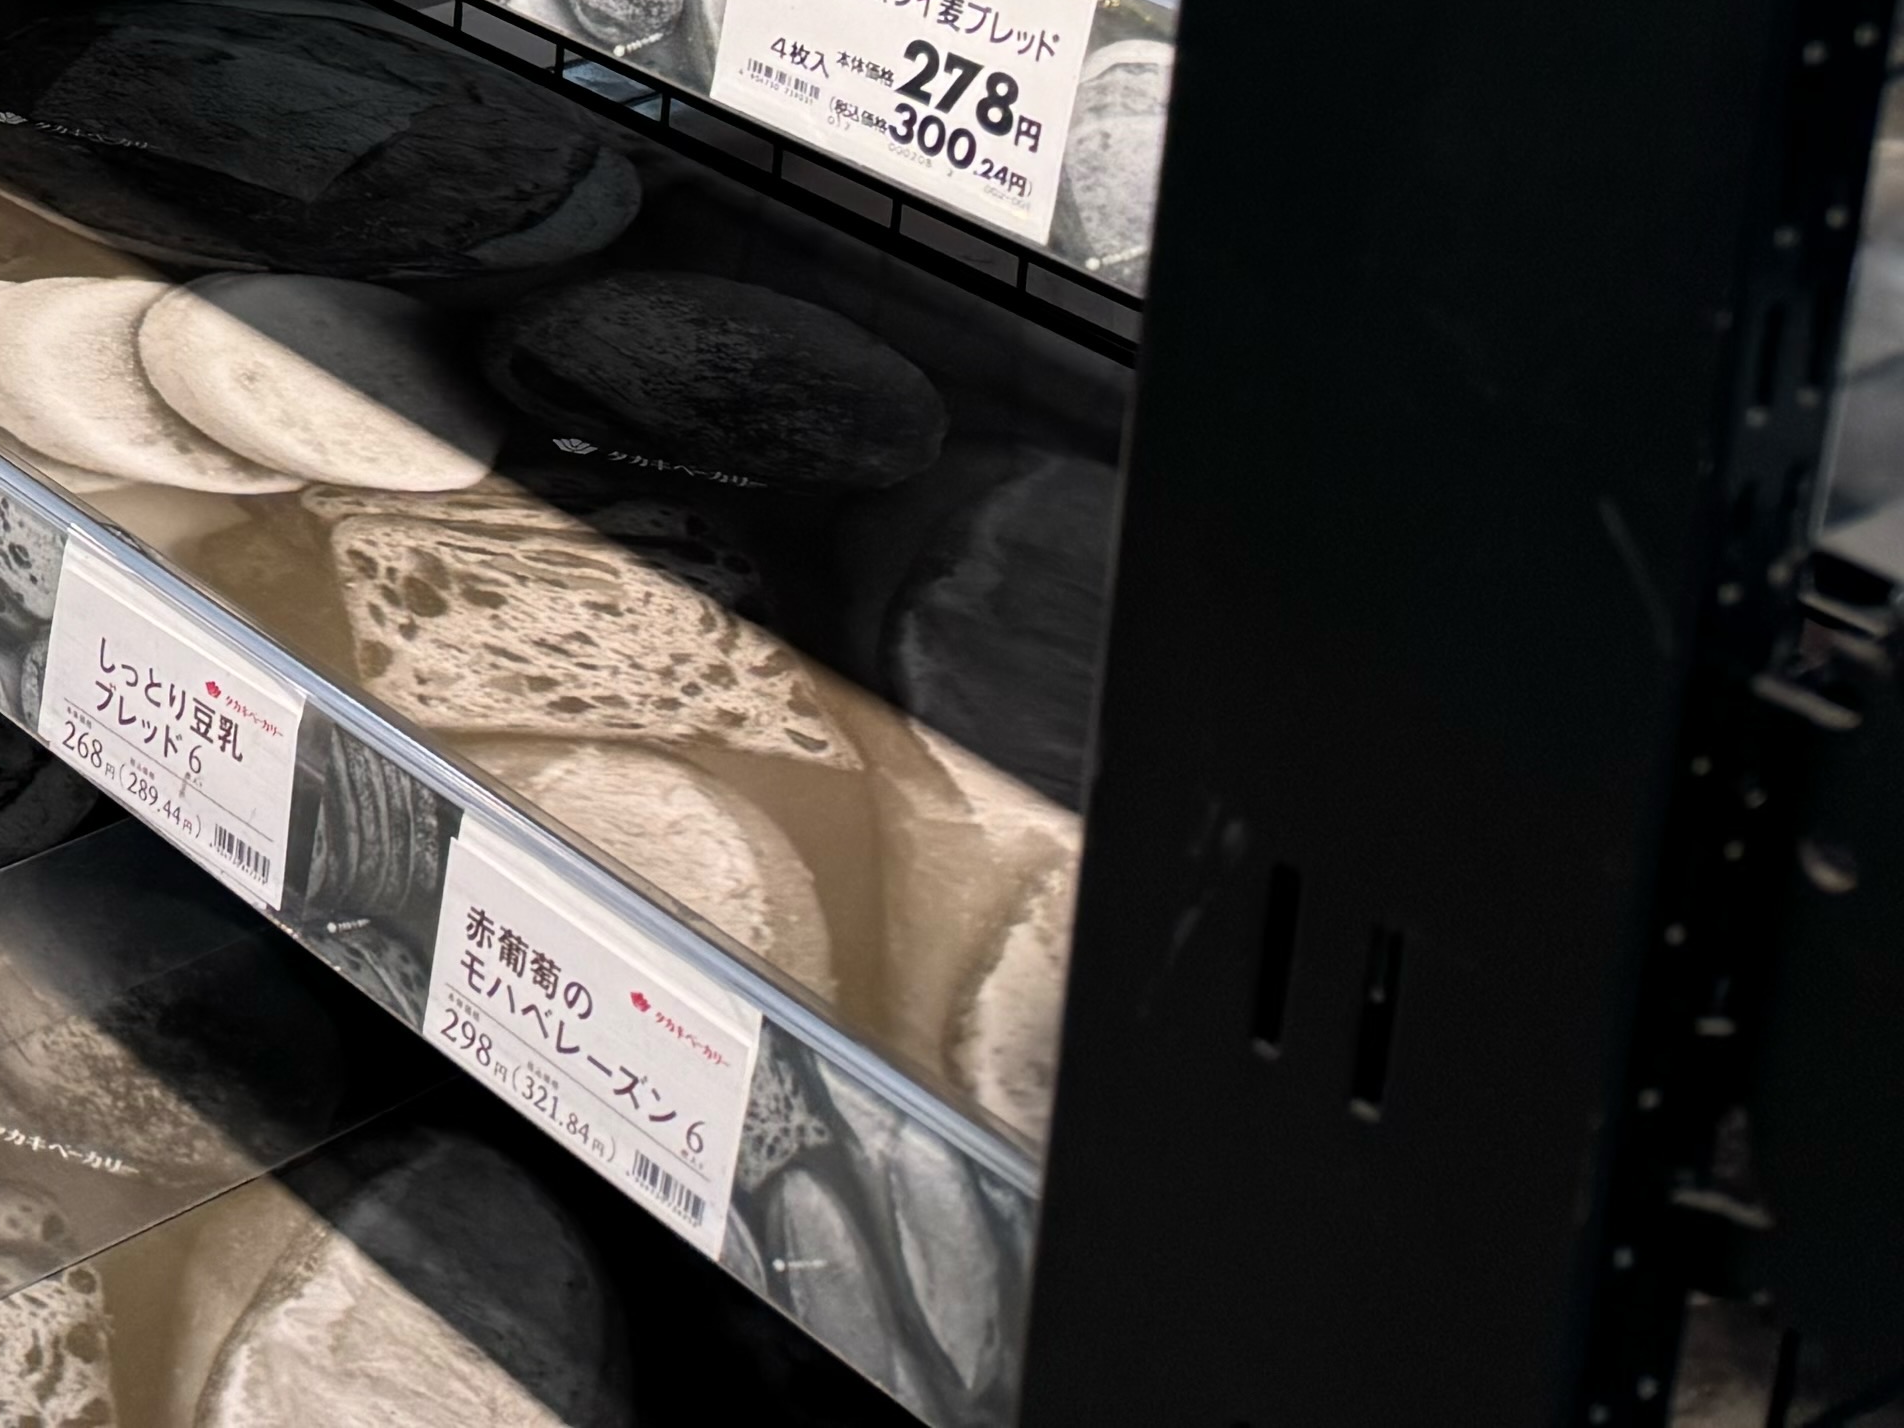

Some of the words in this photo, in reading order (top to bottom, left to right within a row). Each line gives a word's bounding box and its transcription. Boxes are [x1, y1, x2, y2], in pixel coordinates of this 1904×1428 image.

[769, 36, 829, 80] 4枚入
[836, 50, 894, 87] 本体価格
[896, 39, 1042, 154] 278円
[95, 680, 184, 758] ブレッド
[188, 745, 202, 775] 6
[99, 637, 243, 763] しっとり豆乳
[226, 695, 284, 738] タカキベーカリー
[61, 721, 117, 781] 268円
[119, 762, 202, 840] (289.44円)
[466, 905, 593, 1020] 赤葡萄の
[439, 1007, 508, 1084] 298円
[513, 1064, 617, 1163] (321.84円)
[460, 950, 678, 1125] モハベレーズン
[685, 1120, 706, 1155] 6
[655, 1010, 731, 1068] タカキベーカリー
